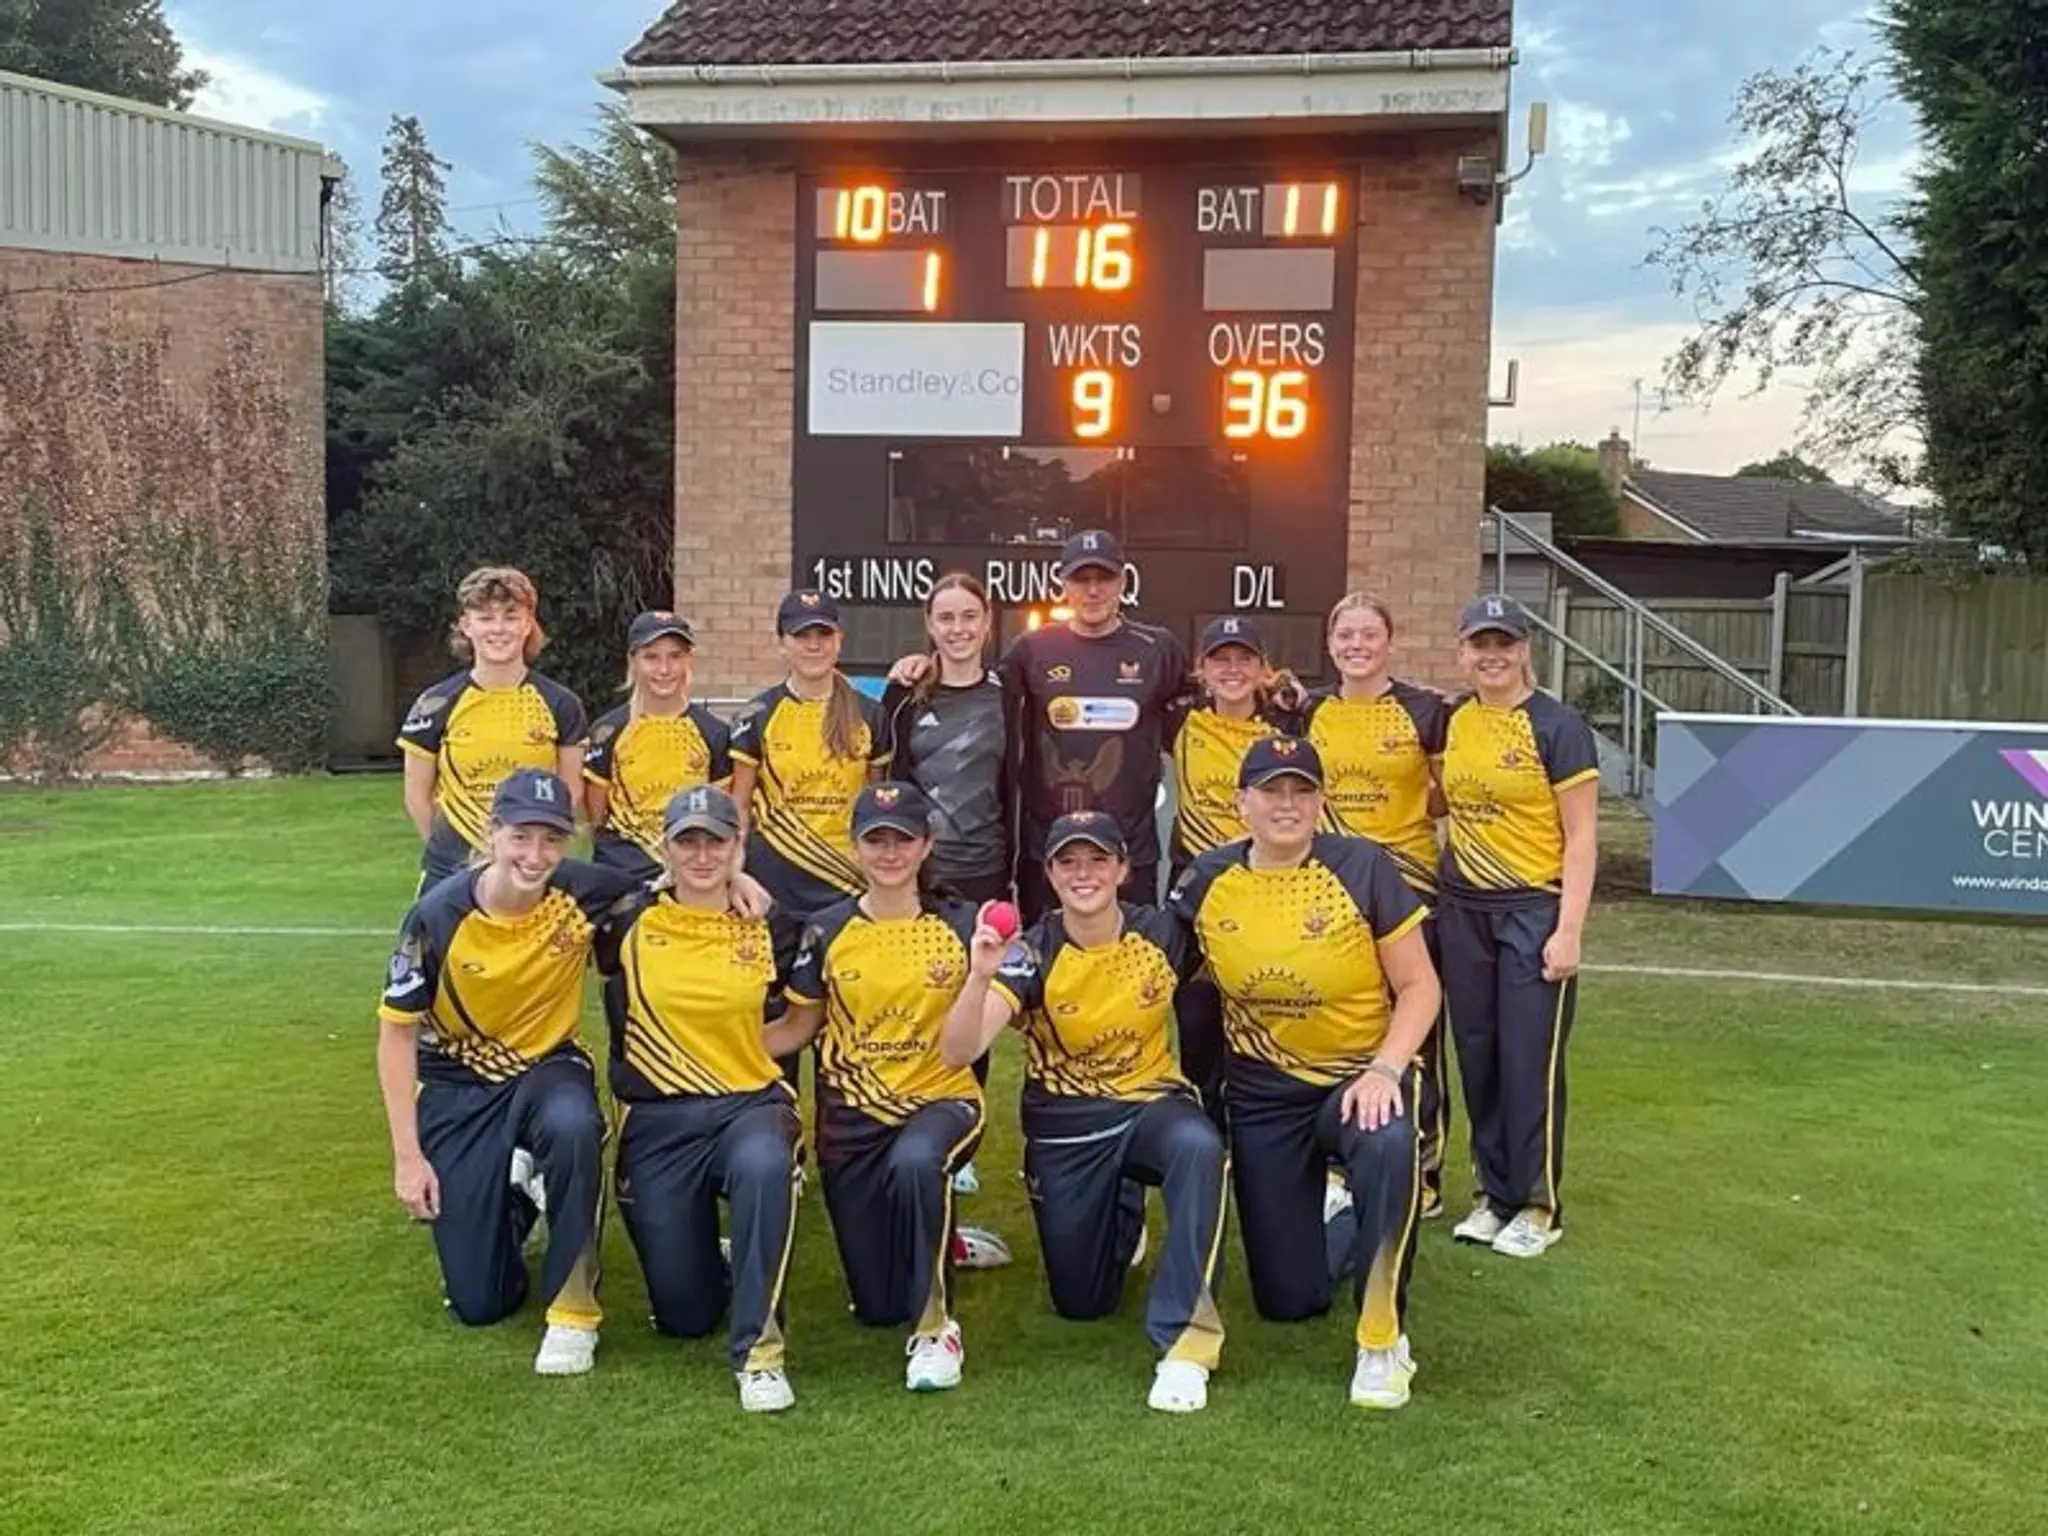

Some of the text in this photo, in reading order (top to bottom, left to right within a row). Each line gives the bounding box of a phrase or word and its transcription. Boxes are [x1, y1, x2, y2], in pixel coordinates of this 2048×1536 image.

[834, 186, 885, 242] 10
[888, 191, 946, 234] BAT
[1007, 176, 1137, 220] TOTAL
[1196, 187, 1259, 232] BAT
[1282, 183, 1339, 237] 11
[1031, 224, 1133, 291] 116
[922, 250, 941, 312] 1
[1047, 323, 1142, 367] WKTS
[1208, 321, 1326, 366] OVERS
[1071, 370, 1115, 438] 9
[1223, 369, 1309, 439] 36
[813, 557, 934, 600] 1st INNS
[987, 560, 1067, 602] RUNS
[1234, 565, 1285, 608] D/L
